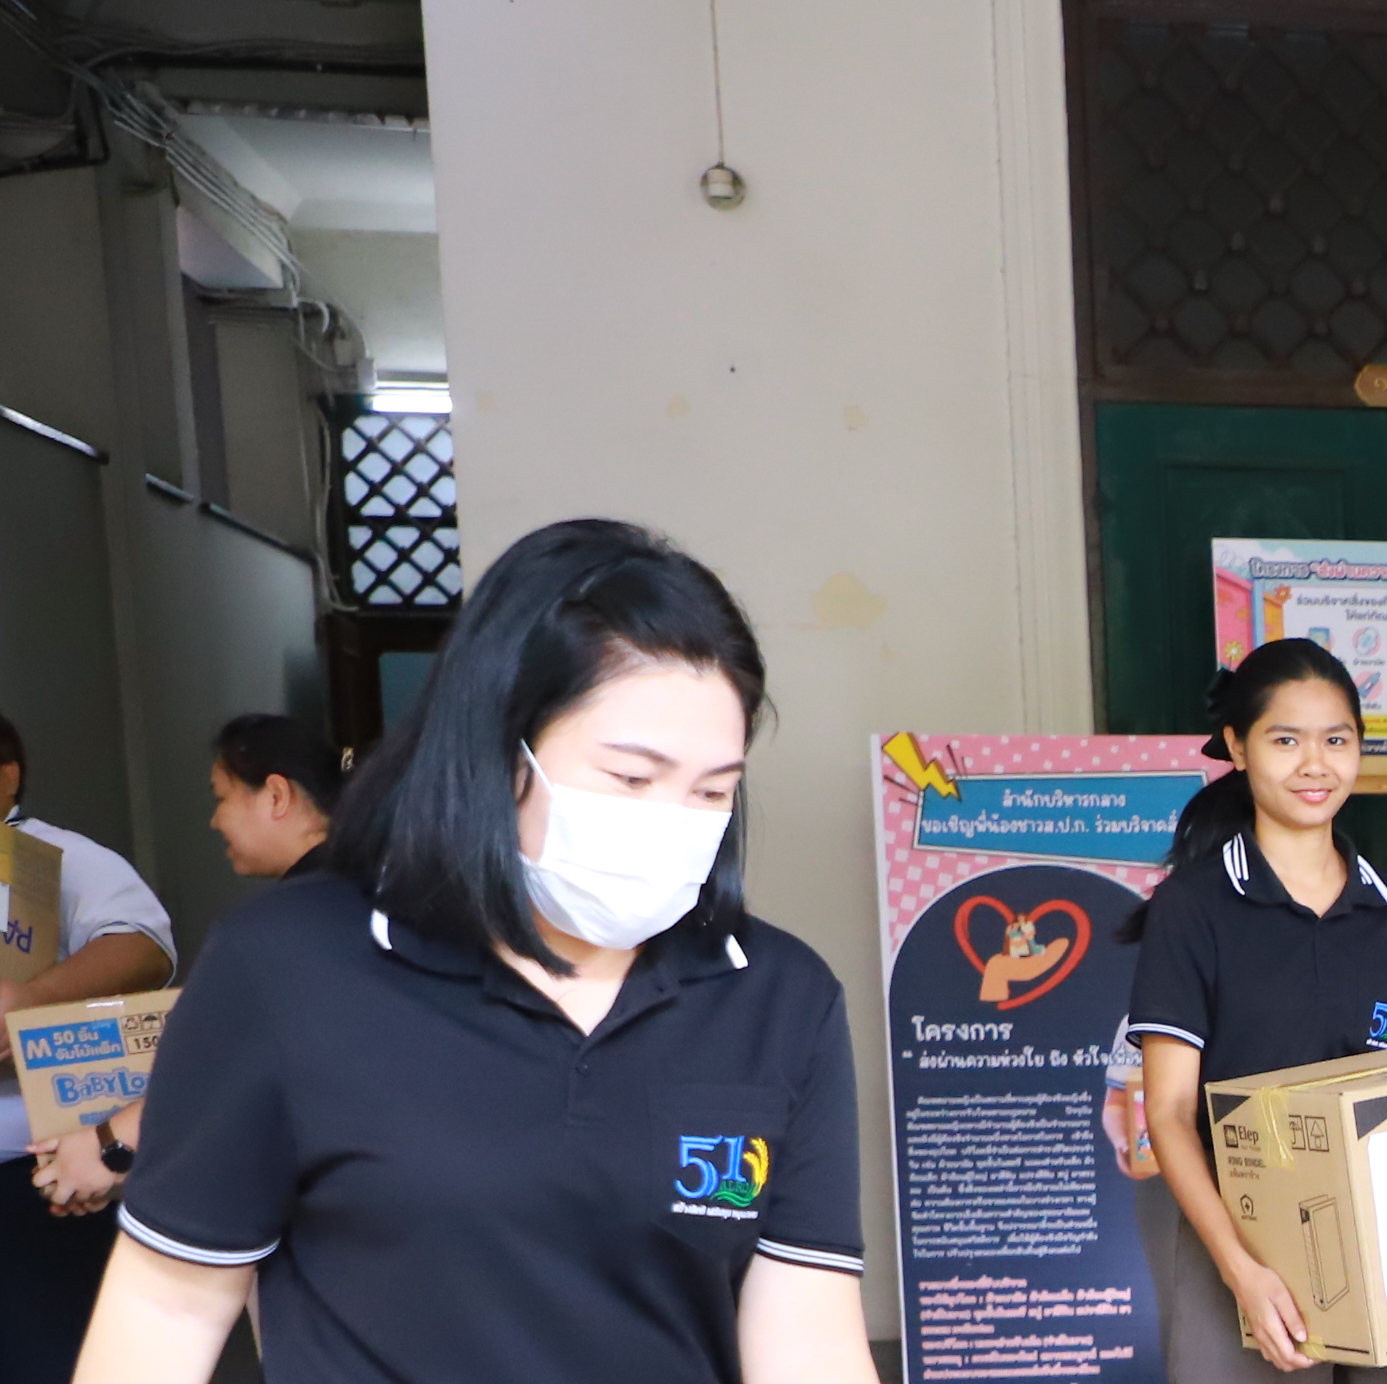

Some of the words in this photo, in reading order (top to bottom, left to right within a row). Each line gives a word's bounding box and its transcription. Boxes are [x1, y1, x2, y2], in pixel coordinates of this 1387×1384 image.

[1002, 788, 1127, 809] สำนักบริหารกลาง
[53, 1030, 75, 1046] 50
[911, 1015, 1014, 1042] โครงการ
[26, 1038, 52, 1060] M
[674, 1135, 745, 1199] 51
